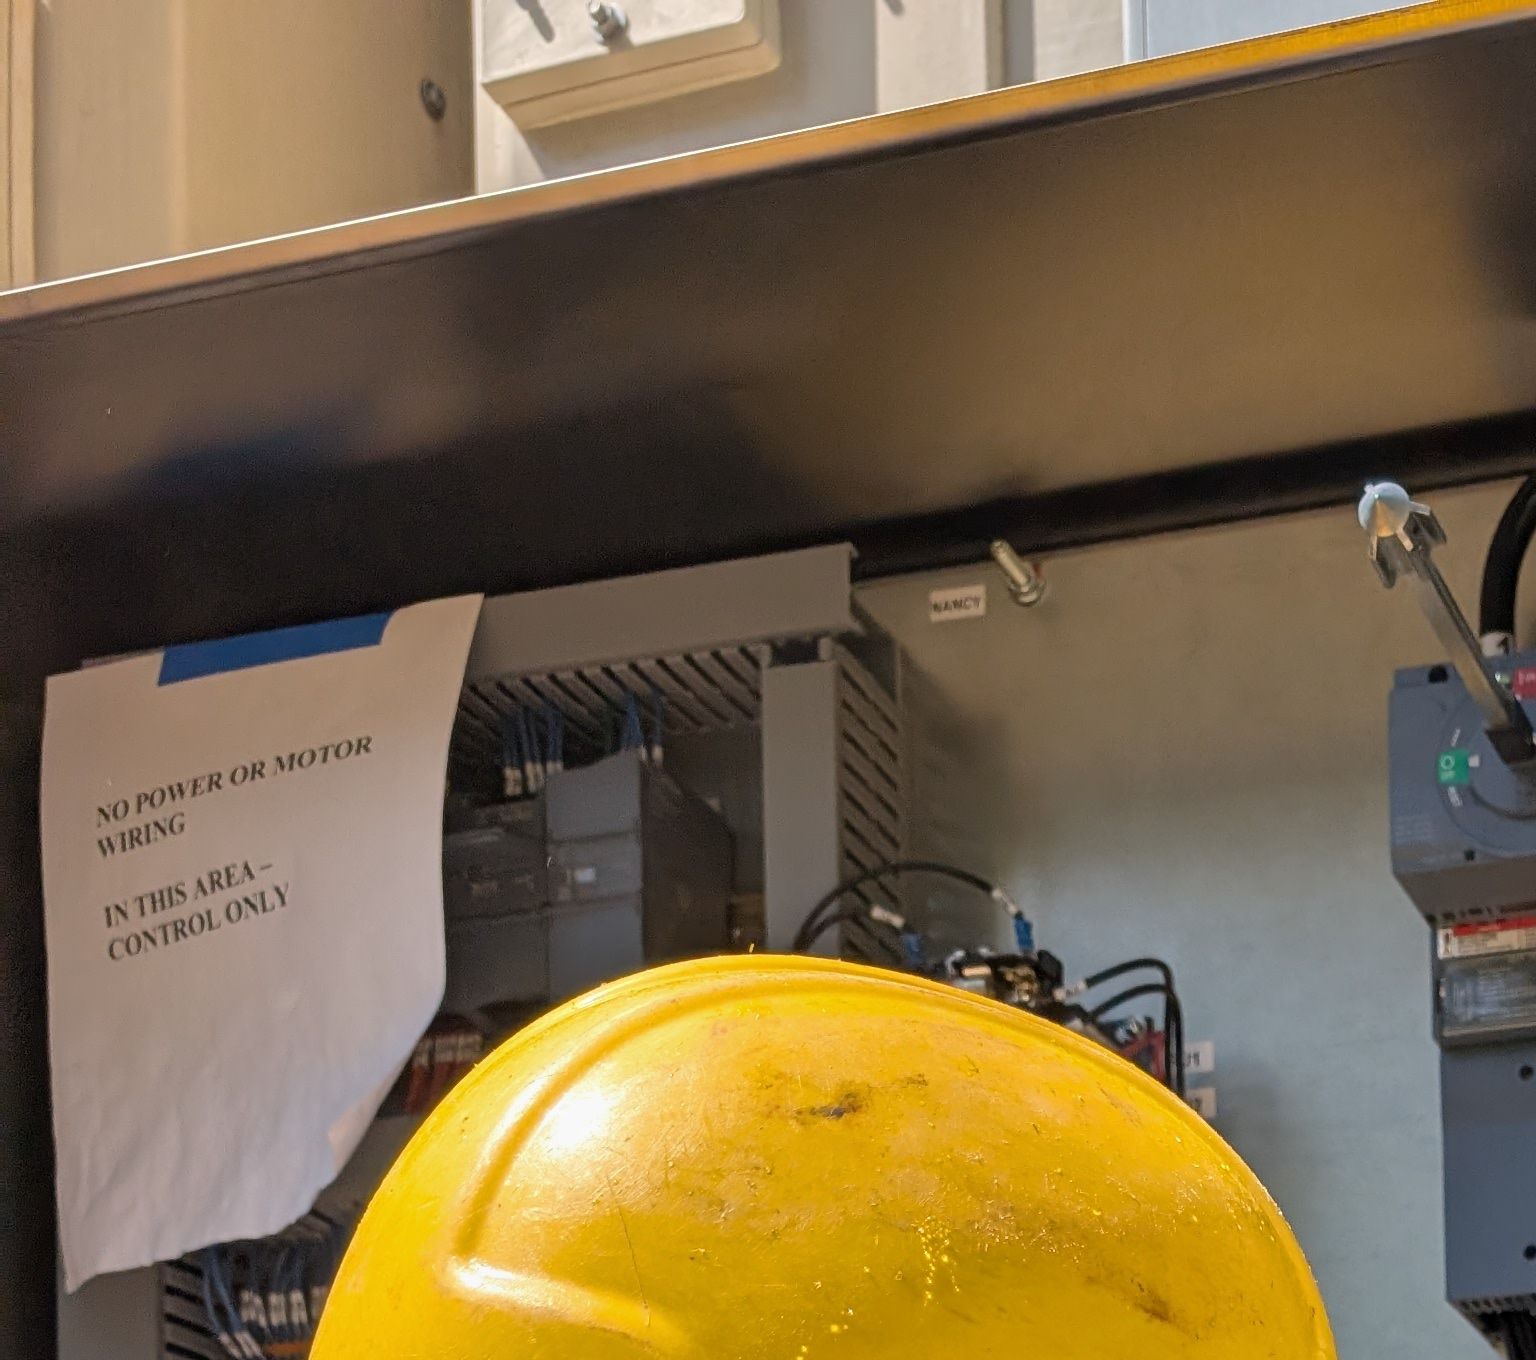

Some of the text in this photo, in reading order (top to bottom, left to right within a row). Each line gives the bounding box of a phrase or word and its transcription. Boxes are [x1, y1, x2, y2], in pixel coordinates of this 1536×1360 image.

[96, 735, 373, 828] NO POWER OR MOTOR
[97, 812, 185, 858] WIRING
[104, 903, 129, 929] IN
[135, 882, 188, 918] THIS
[195, 860, 256, 900] AREA
[107, 882, 289, 962] CONTROL ONLY
